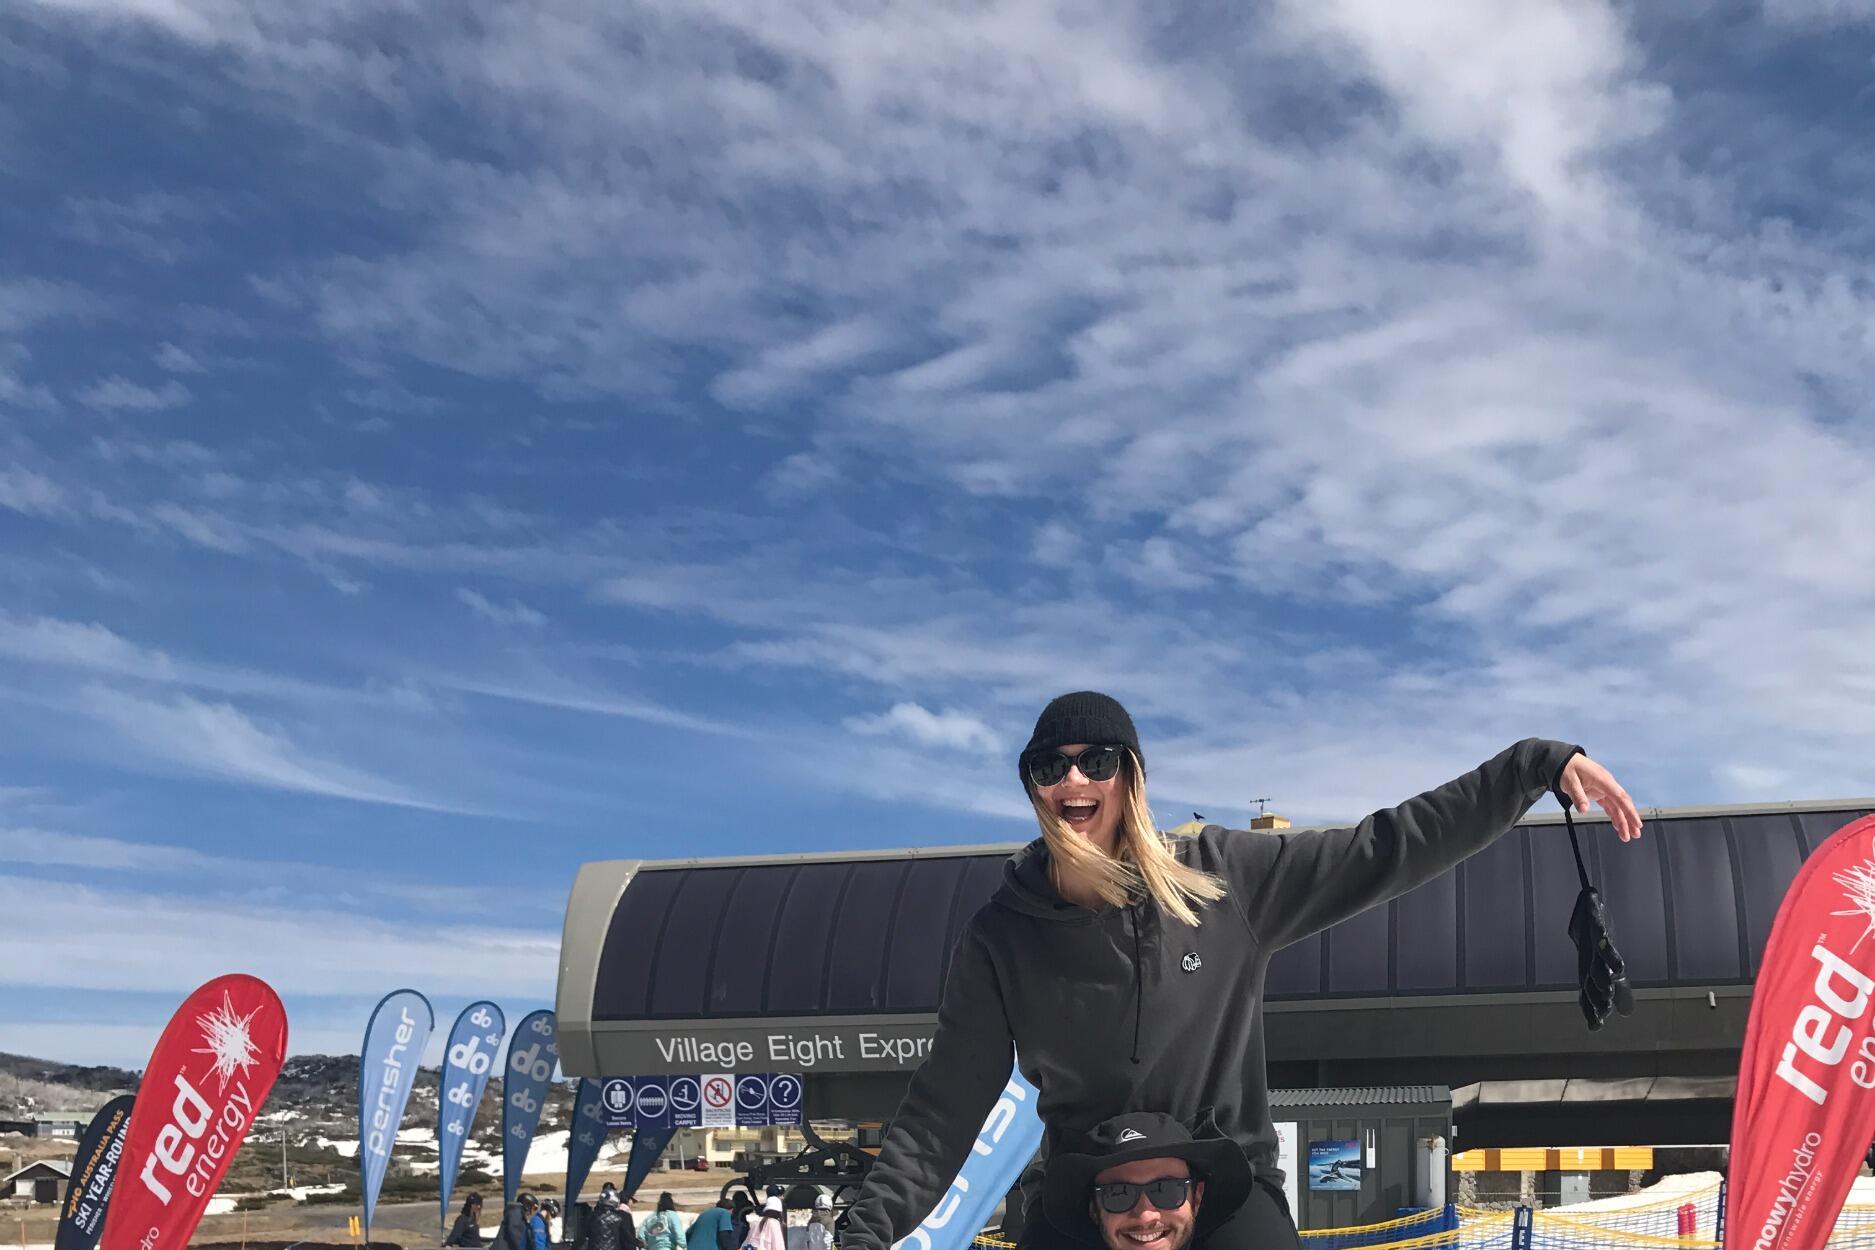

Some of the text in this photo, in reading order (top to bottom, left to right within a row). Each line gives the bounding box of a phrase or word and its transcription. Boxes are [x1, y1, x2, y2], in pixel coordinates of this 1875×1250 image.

[470, 1008, 492, 1028] do
[1775, 944, 1875, 1105] red
[448, 1035, 490, 1075] do
[510, 1043, 550, 1082] do
[655, 1033, 934, 1067] Village Eight Expr
[369, 1007, 415, 1156] perisher
[447, 1082, 473, 1108] do
[511, 1088, 536, 1113] do
[140, 1074, 214, 1206] red
[186, 1081, 252, 1198] energy
[447, 1119, 464, 1136] do
[81, 1135, 110, 1187] AUSTRALIA
[107, 1109, 124, 1134] PASS
[75, 1203, 92, 1229] SKI
